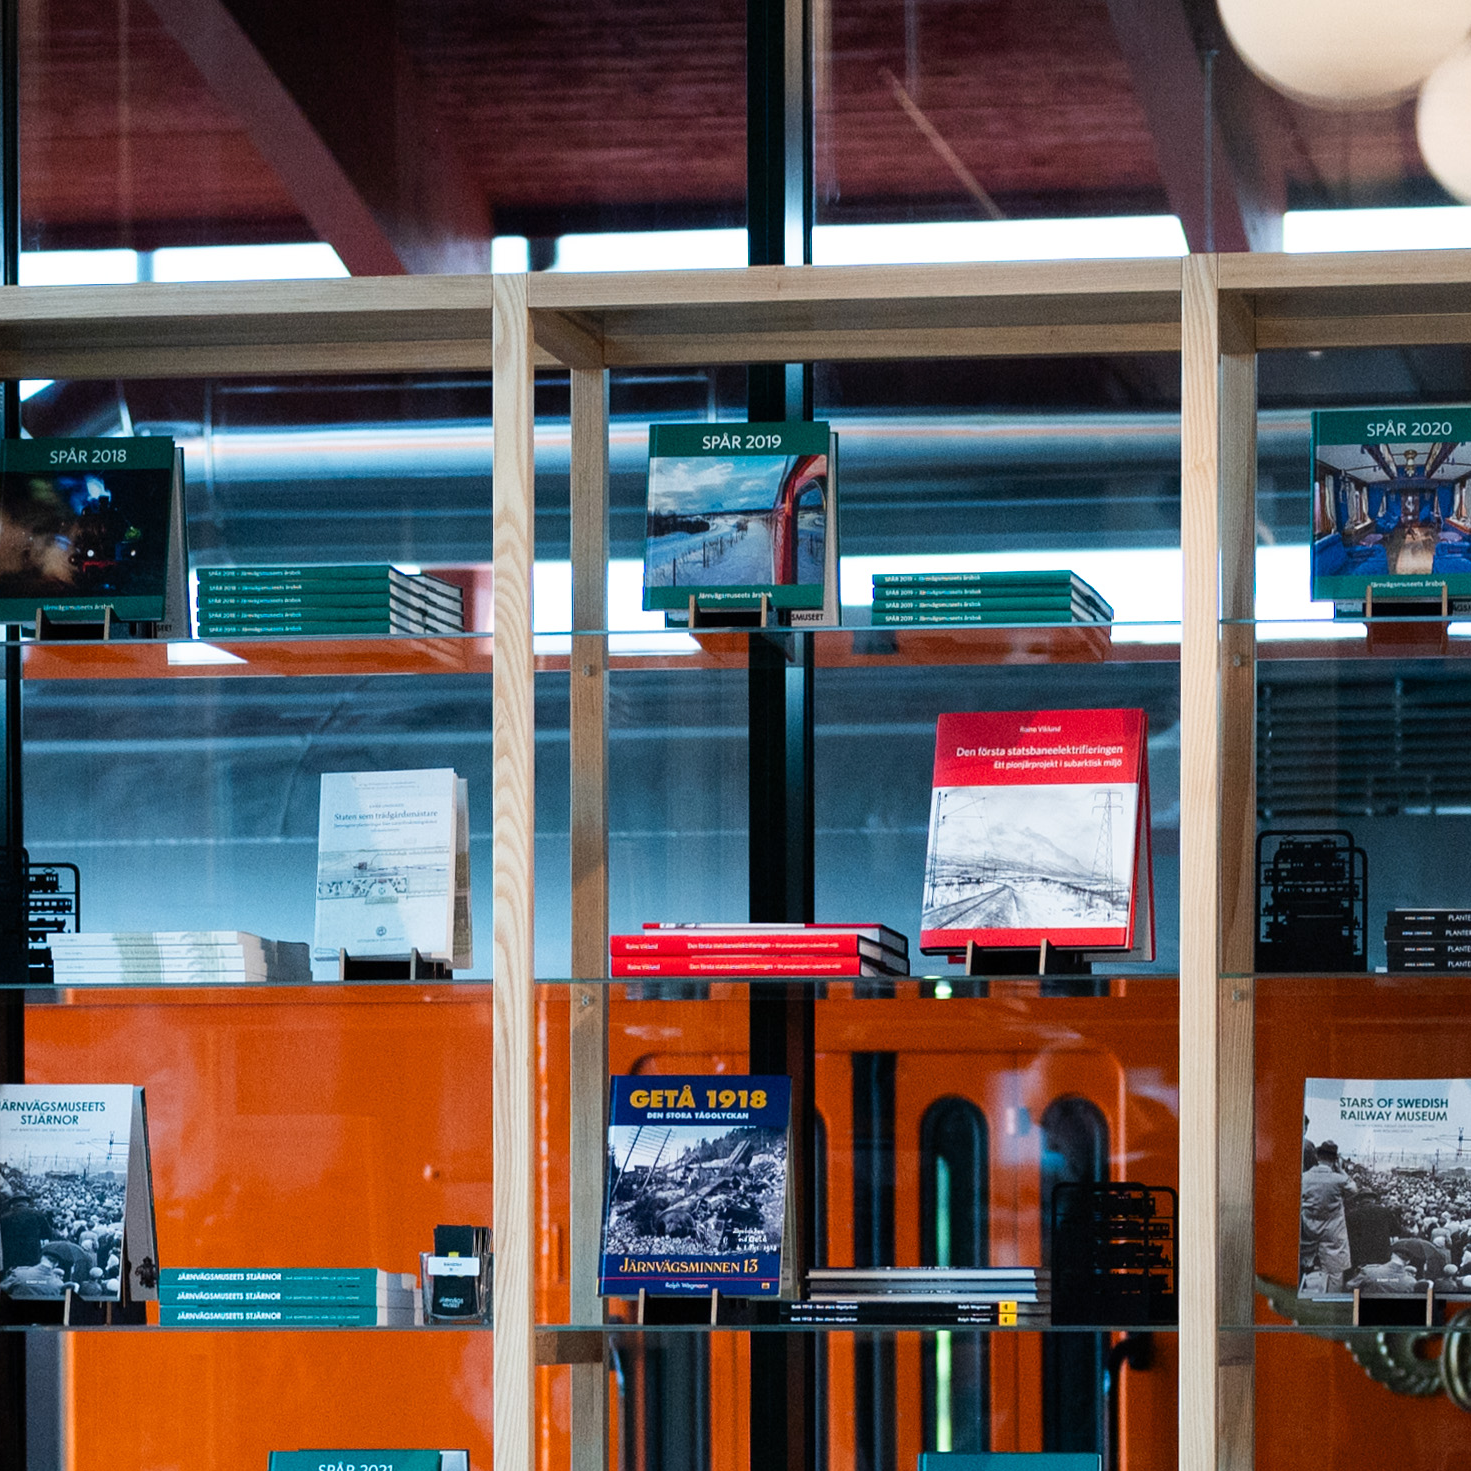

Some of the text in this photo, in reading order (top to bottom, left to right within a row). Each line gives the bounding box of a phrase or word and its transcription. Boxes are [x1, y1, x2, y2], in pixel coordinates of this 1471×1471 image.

[1367, 420, 1452, 437] SPÅR 2020
[702, 433, 782, 450] SPÅR 2019
[50, 448, 127, 464] SPÅR 2018
[1039, 725, 1061, 733] Viklund
[957, 745, 1123, 756] Den första statsbaneelektrifieringen
[994, 761, 1005, 769] Ett
[1006, 760, 1058, 771] pionjärprojekt
[1064, 760, 1102, 768] subarktisk
[1104, 759, 1123, 768] miljö
[689, 963, 700, 971] Den
[630, 1085, 767, 1109] GETÅ 1918
[1340, 1098, 1448, 1108] STARS OF SWEDISH
[21, 1112, 79, 1125] STJÄRNOR
[695, 1111, 749, 1119] TÅGOLYCKAN
[1341, 1110, 1448, 1121] RAILWAY MUSEUM
[619, 1258, 758, 1274] JÄRNVÄGSMINNEN 13
[178, 1272, 244, 1280] JÄRNVÄGSMUSEETS
[246, 1272, 281, 1281] STJÄRNOR
[177, 1291, 244, 1300] JÄRNVÄGSMUSEETS
[245, 1292, 281, 1300] STJÄRNOR
[177, 1311, 281, 1320] JÄRNVÄGSMUSEETS STJÄRNOR
